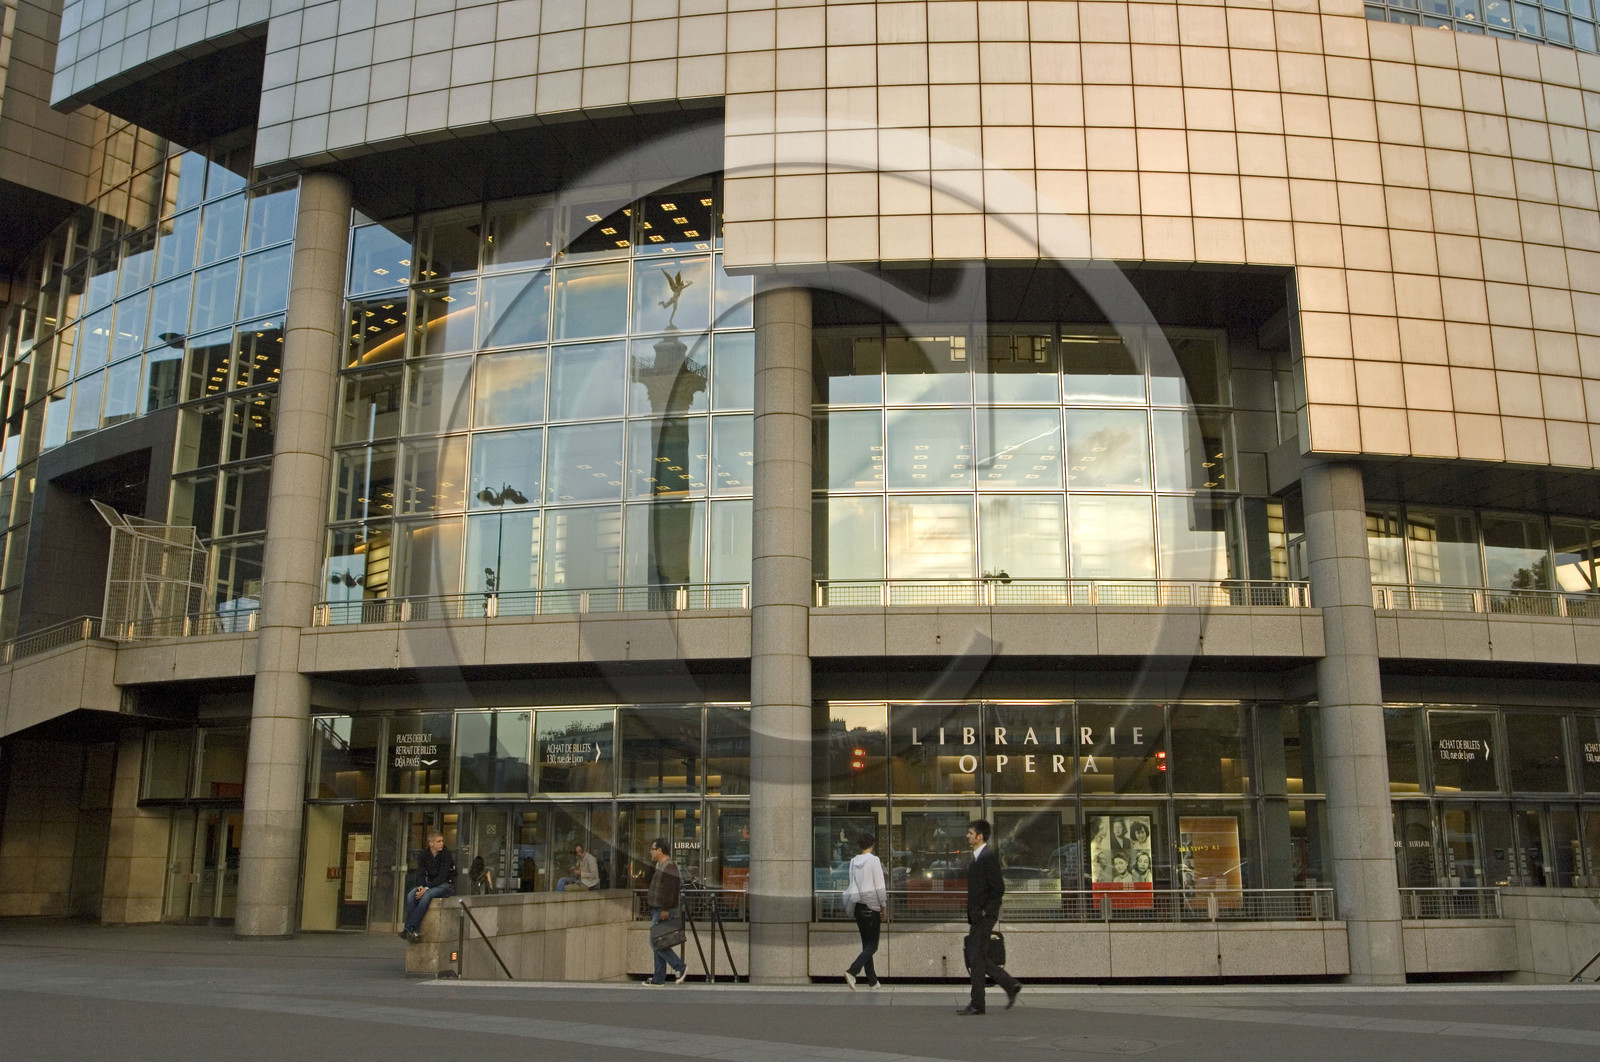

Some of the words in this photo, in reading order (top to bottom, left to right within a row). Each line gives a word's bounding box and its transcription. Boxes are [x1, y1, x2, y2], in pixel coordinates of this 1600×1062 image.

[396, 733, 412, 743] PLACES
[412, 733, 433, 743] DEBOUT
[912, 727, 1144, 745] LIBRAIRIE
[395, 745, 413, 755] RETRAIT
[413, 745, 421, 755] DE
[421, 745, 438, 755] BILLETS
[547, 743, 565, 754] ACHAT
[565, 743, 573, 753] DE
[573, 743, 591, 753] BILLETS
[1439, 739, 1456, 750] ACHAT
[1456, 739, 1464, 750] DE
[1464, 740, 1481, 750] BILLETS
[556, 756, 565, 764] rue
[565, 754, 572, 764] de
[572, 754, 584, 766] Lyon
[1458, 750, 1464, 760] de
[1464, 750, 1475, 763] Lyon
[959, 754, 1098, 773] OPERA
